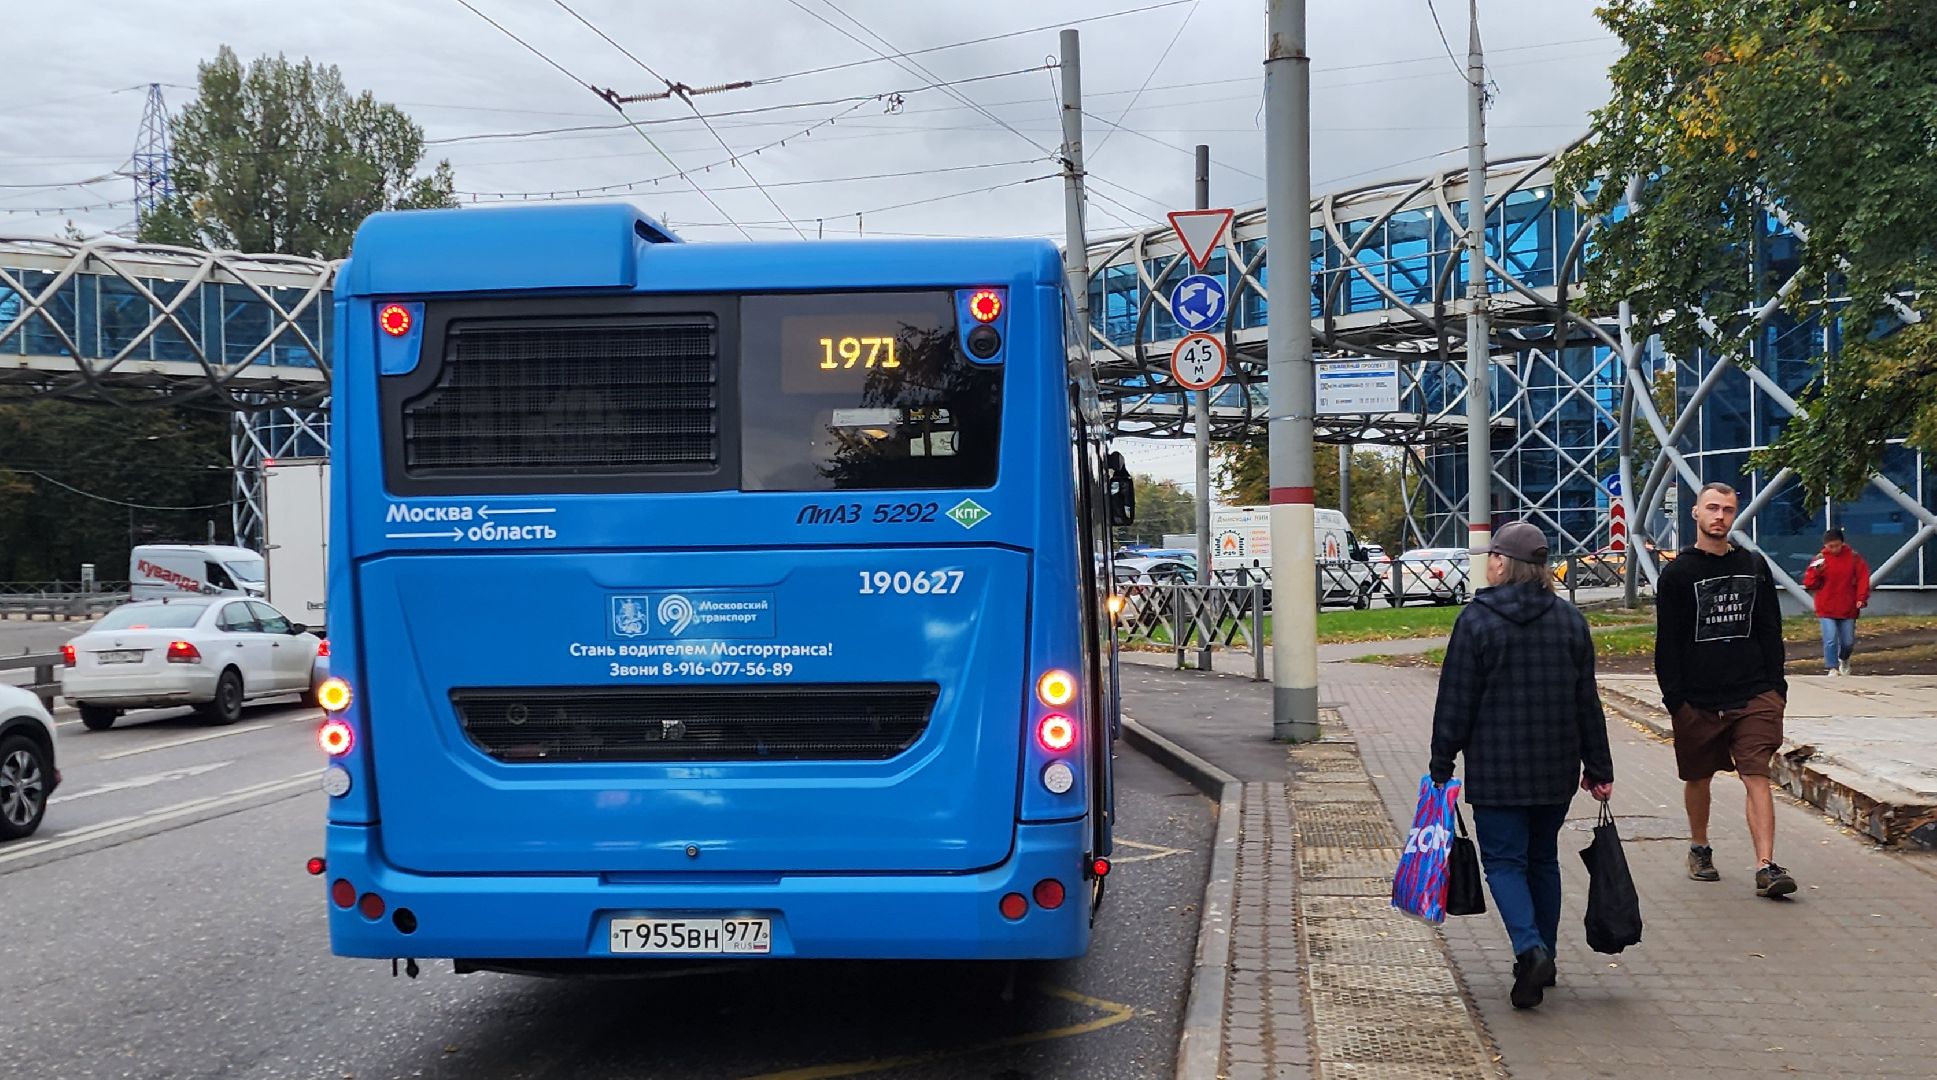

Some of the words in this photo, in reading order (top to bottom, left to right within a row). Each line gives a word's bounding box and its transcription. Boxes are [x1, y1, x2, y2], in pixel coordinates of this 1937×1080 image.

[820, 337, 901, 369] 1971
[1184, 345, 1212, 364] 4,5
[385, 503, 473, 523] Москва
[796, 504, 863, 524] ЛиАЗ
[872, 502, 939, 523] 5292
[955, 507, 981, 520] КПГ
[467, 521, 557, 541] область
[859, 570, 964, 595] 190627
[700, 600, 768, 610] Московский
[701, 612, 757, 623] транспорт
[569, 643, 615, 657] Стань
[619, 644, 706, 658] водителем
[711, 642, 833, 658] Мосгортранса!
[610, 663, 658, 676] Звони
[662, 662, 793, 677] 8-916-077-56-89
[724, 922, 763, 941] 977
[733, 942, 753, 950] RUS
